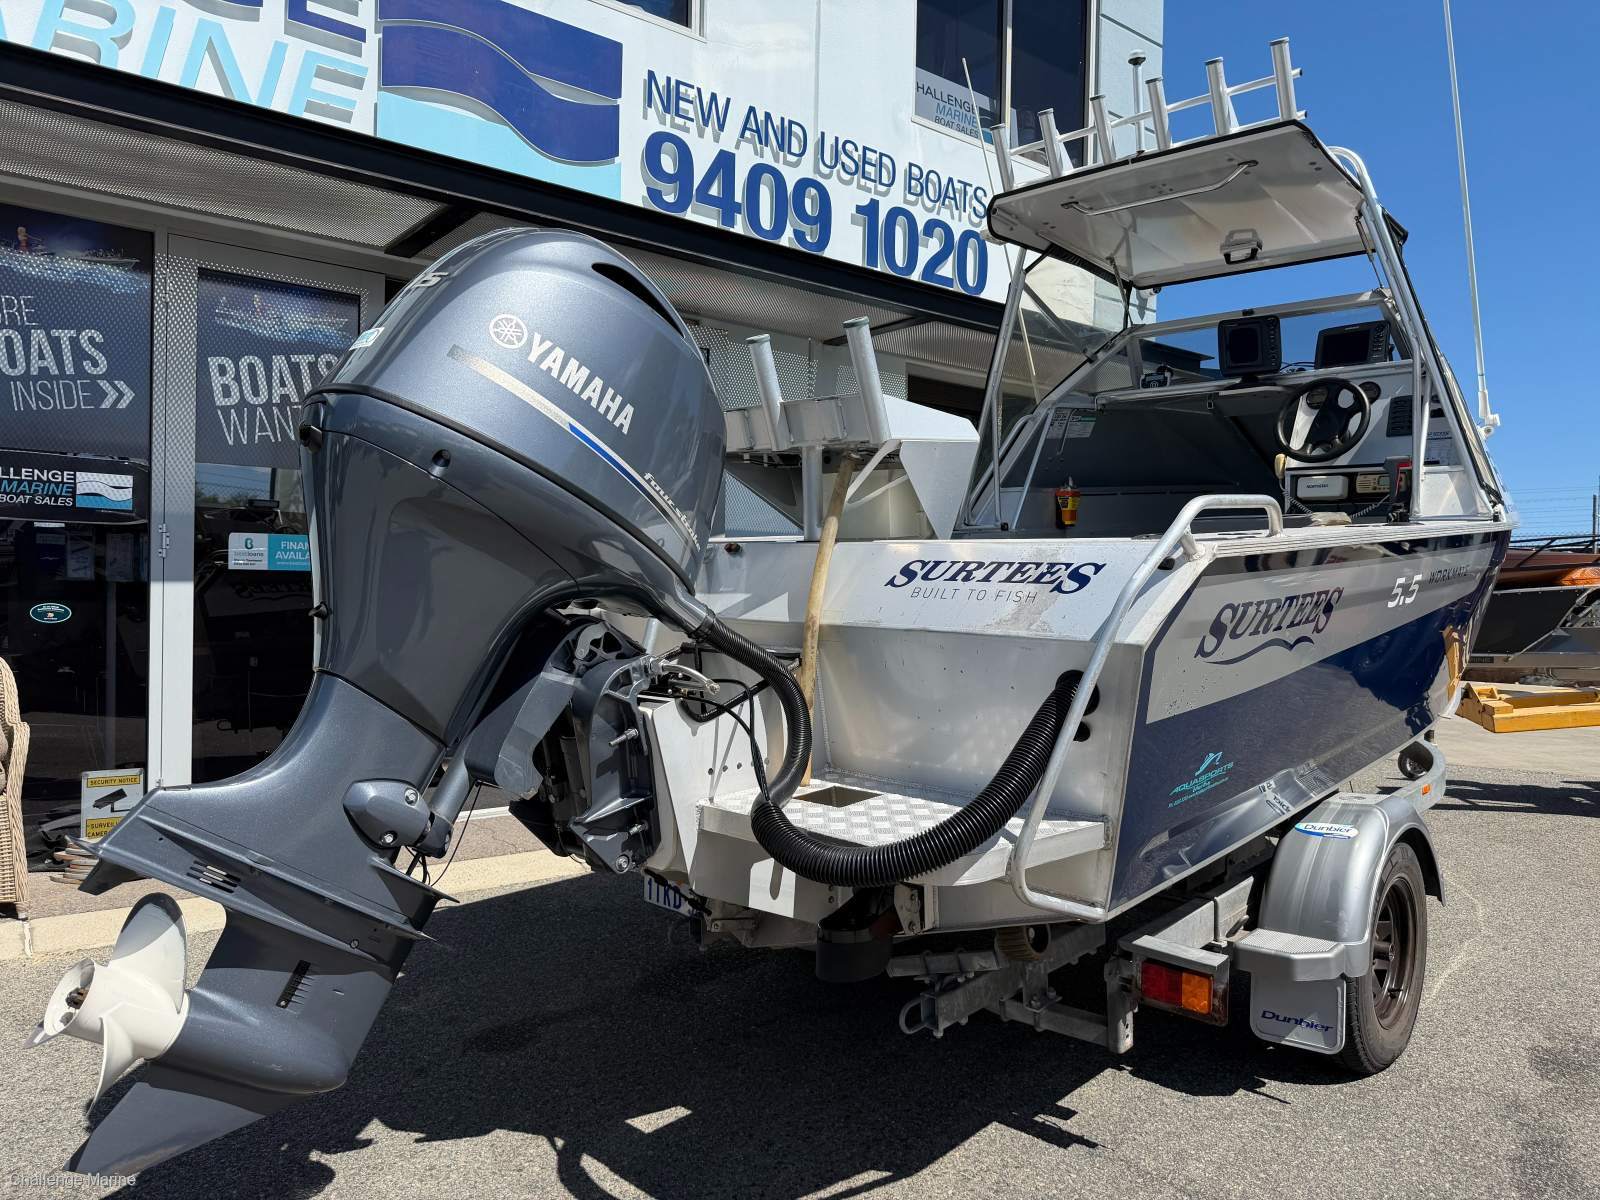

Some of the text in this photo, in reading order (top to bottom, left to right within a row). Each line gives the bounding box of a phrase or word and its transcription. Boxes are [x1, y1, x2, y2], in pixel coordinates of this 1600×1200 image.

[0, 0, 368, 116] RINE
[934, 115, 980, 139] BOAT SALES
[936, 103, 979, 129] MARINE
[646, 69, 988, 219] NEW AND USED BOATS
[644, 131, 988, 296] 9409 1020
[0, 329, 107, 376] OATS
[10, 380, 95, 411] INSIDE
[527, 332, 635, 435] YAMAHA
[217, 405, 301, 446] WAN
[0, 480, 74, 496] MARINE
[0, 494, 73, 507] BOAT SALES
[884, 559, 1107, 595] SURTEES
[1387, 574, 1423, 608] 5.5
[910, 586, 1038, 604] BUILT TO FISH
[1194, 587, 1344, 658] SURTEES
[1304, 823, 1354, 834] Dunbier
[1261, 1010, 1334, 1032] Dunbier
